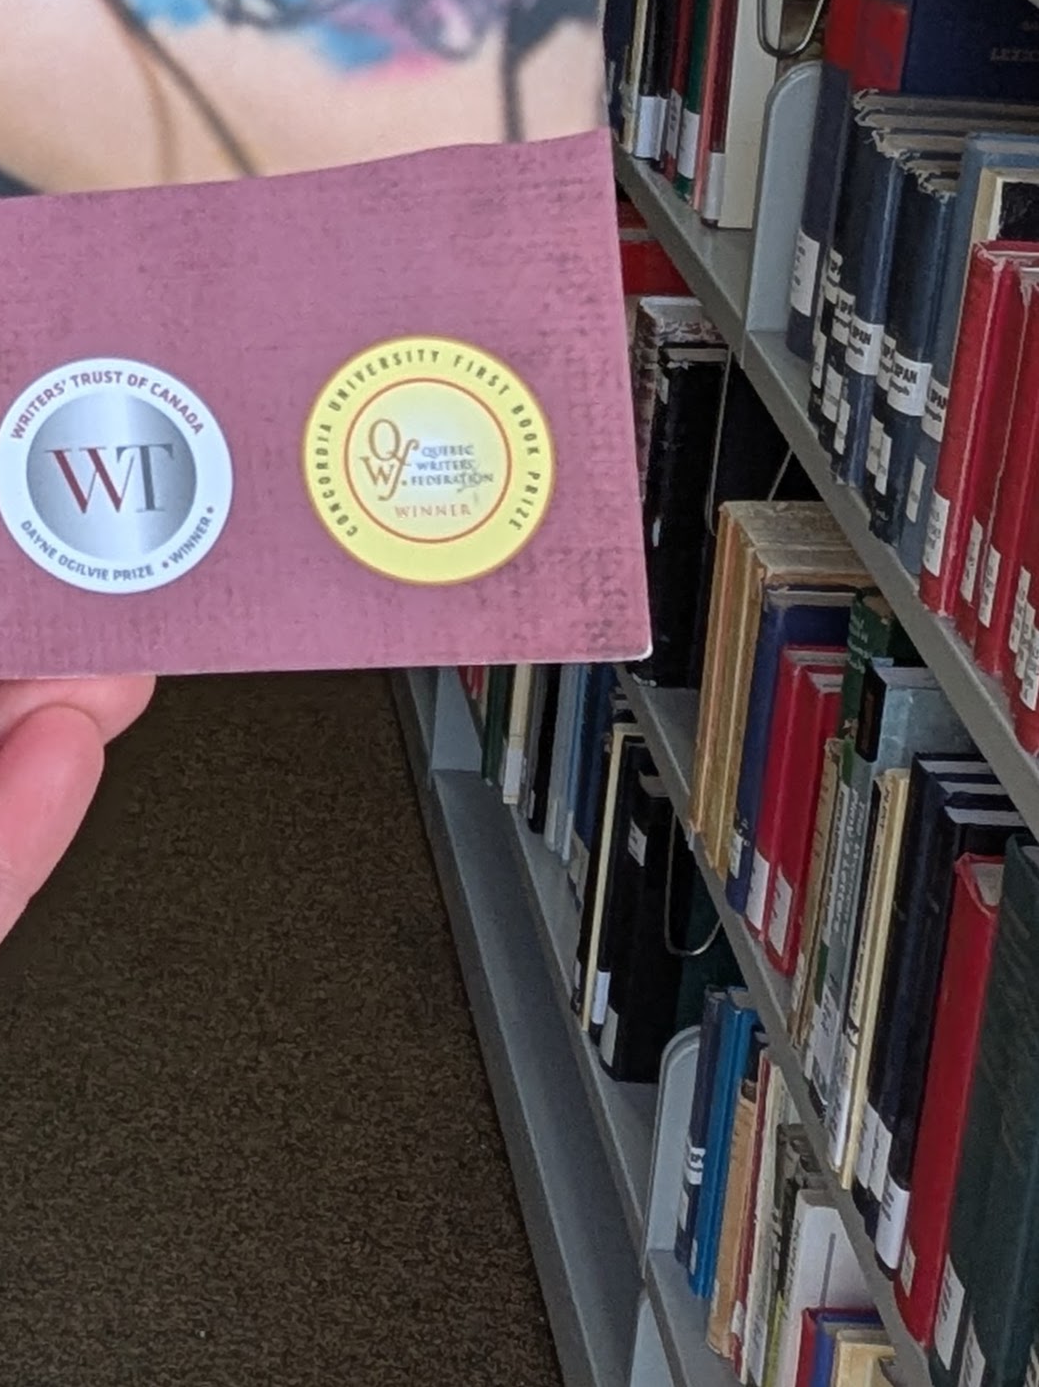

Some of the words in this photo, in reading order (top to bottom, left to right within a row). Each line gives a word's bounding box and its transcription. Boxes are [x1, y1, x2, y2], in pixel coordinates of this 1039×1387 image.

[70, 370, 124, 389] TRUST
[127, 373, 149, 390] OF
[150, 382, 205, 435] CANADA
[328, 349, 440, 413] UNIVERSITY
[453, 354, 510, 396] FIRST
[511, 403, 540, 456] BOOK
[315, 423, 358, 538] CONCORDIA
[394, 503, 472, 519] WINNER
[508, 470, 542, 531] PRIZE
[20, 519, 59, 560] DAYNE
[58, 554, 110, 582] OGILVIE
[113, 565, 155, 582] PRIZE
